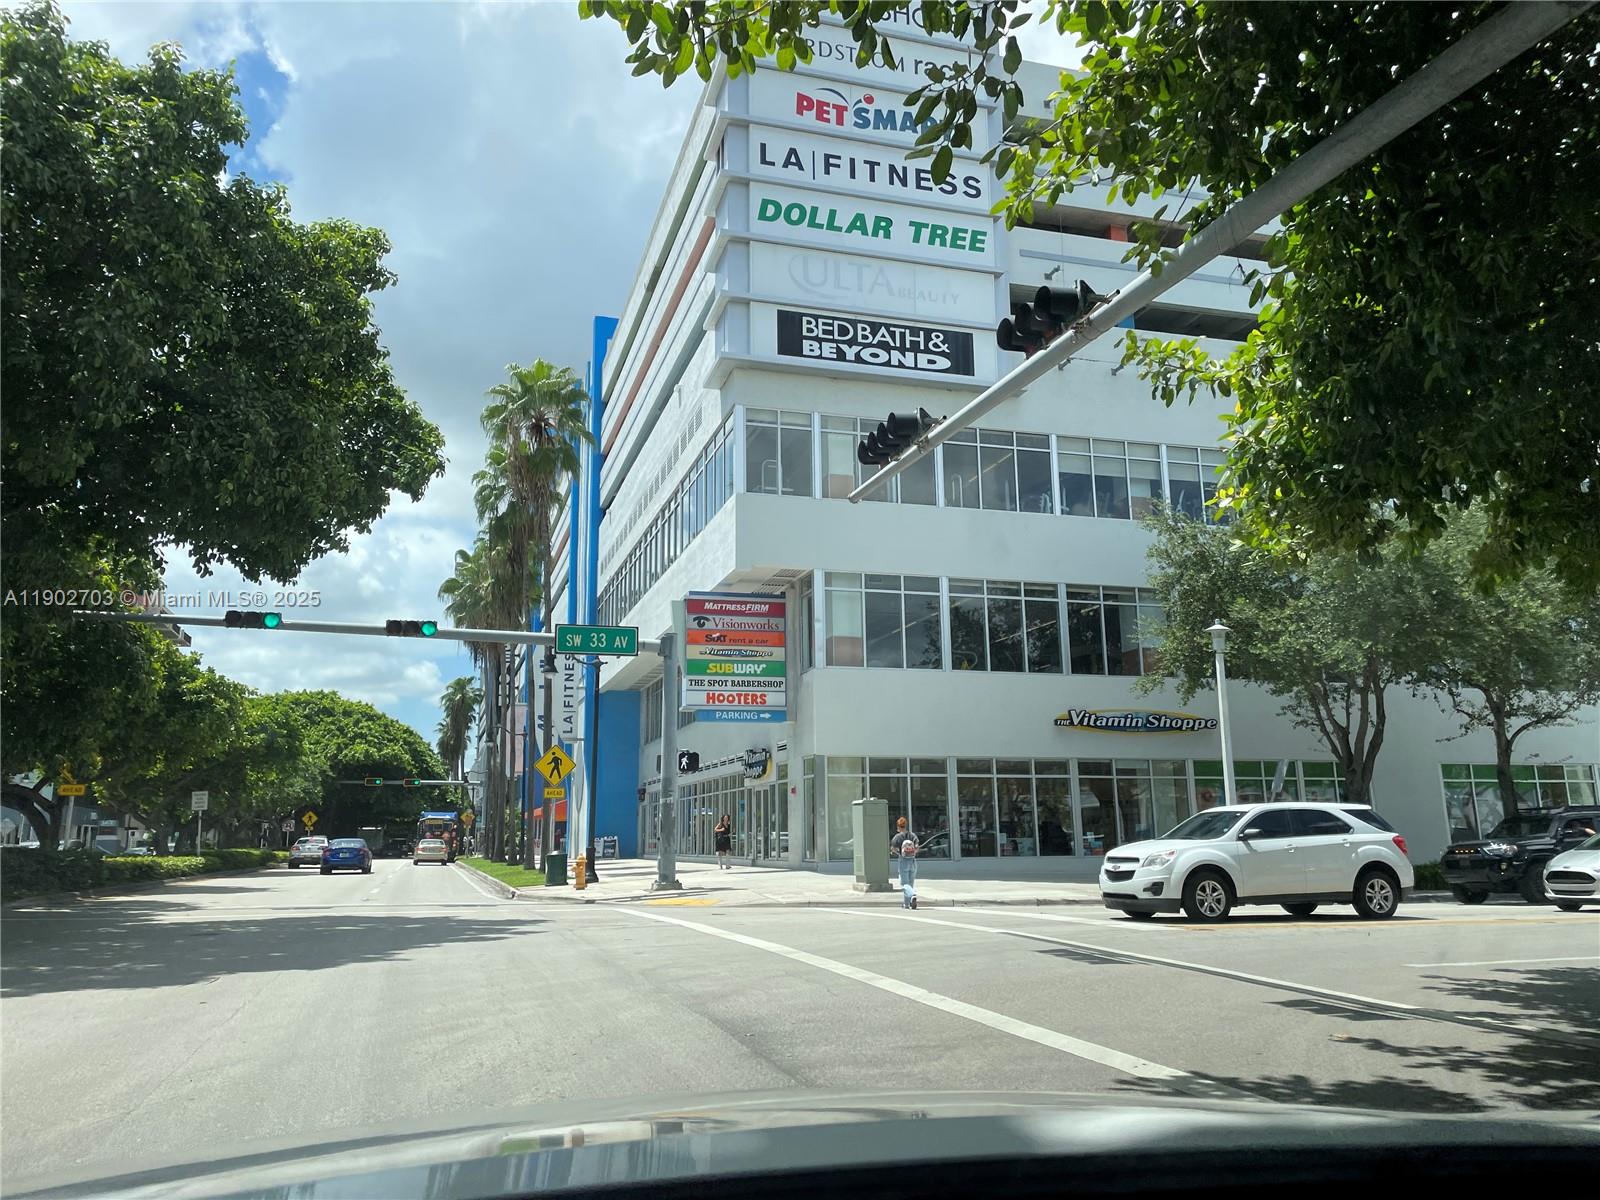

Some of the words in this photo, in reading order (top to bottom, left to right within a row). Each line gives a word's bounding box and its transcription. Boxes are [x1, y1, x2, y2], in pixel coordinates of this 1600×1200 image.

[757, 198, 893, 240] DOLLAR
[909, 221, 987, 253] TREE
[800, 254, 896, 297] ULTA
[898, 287, 960, 304] BEAUTY
[802, 316, 854, 341] BED
[857, 323, 924, 350] BATH
[928, 332, 950, 353] &
[802, 339, 951, 370] BEYOND
[712, 617, 780, 631] Visionworks
[566, 634, 582, 647] SW
[590, 633, 606, 648] 33
[614, 636, 628, 648] AV
[705, 647, 739, 656] Vitamin
[741, 649, 773, 658] Shoppe
[707, 663, 767, 674] SUBWAY
[689, 679, 705, 687] THE
[708, 679, 728, 687] SPOT
[730, 679, 784, 688] BARBERSHOP
[706, 692, 767, 705] HOOTERS
[715, 711, 758, 720] PARKING
[1069, 709, 1142, 728] Vitamin
[1146, 714, 1218, 730] Shoppe
